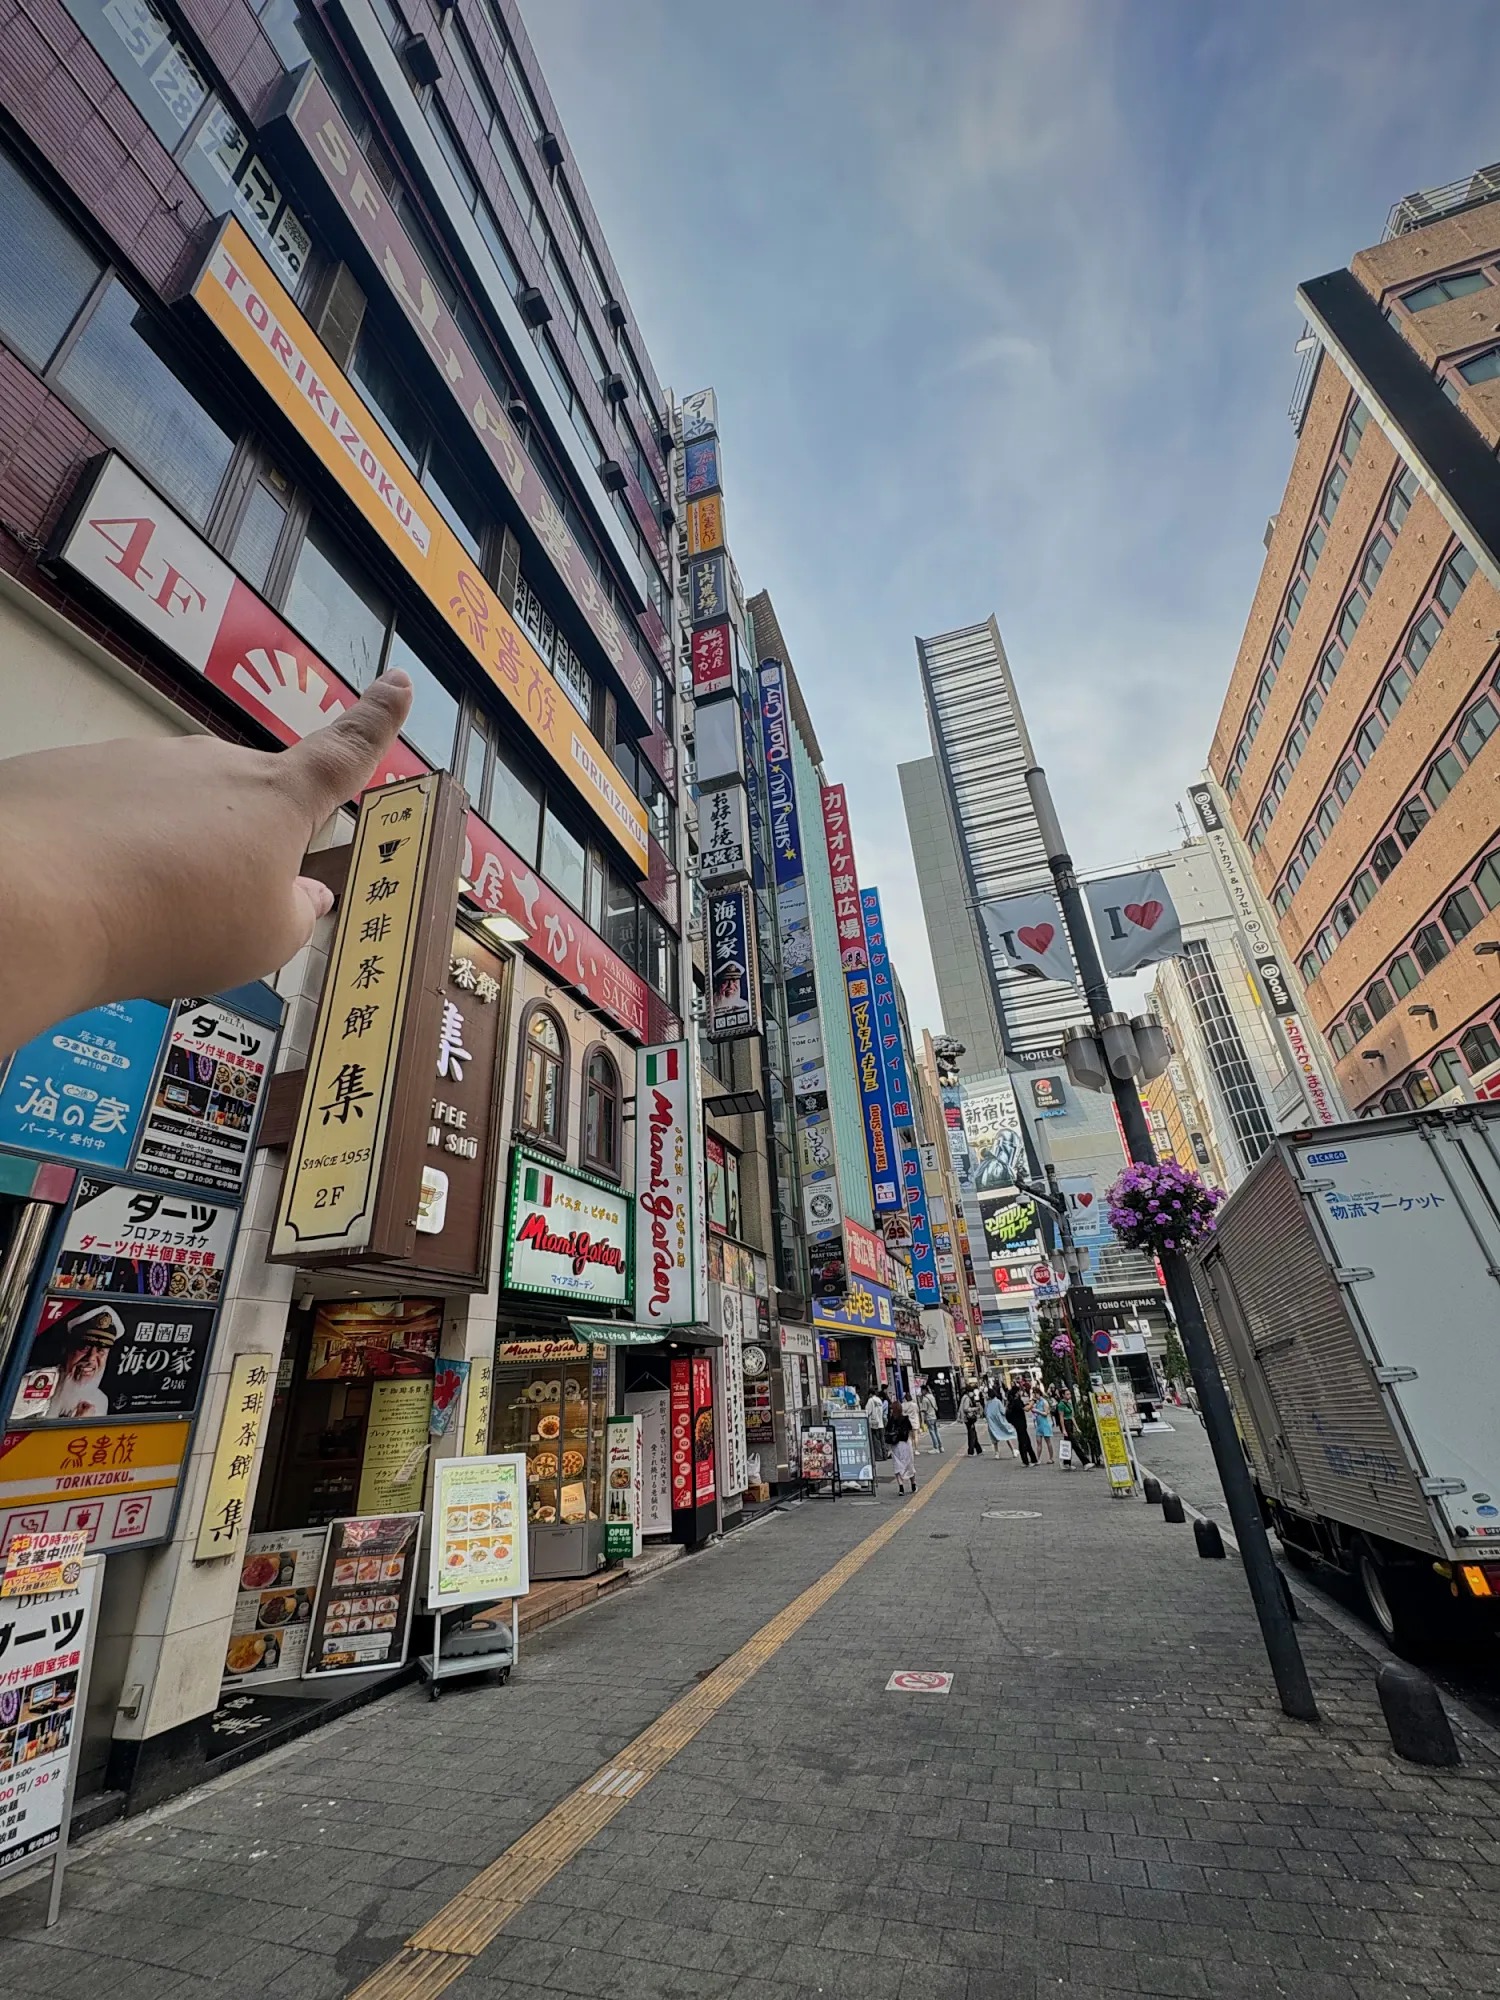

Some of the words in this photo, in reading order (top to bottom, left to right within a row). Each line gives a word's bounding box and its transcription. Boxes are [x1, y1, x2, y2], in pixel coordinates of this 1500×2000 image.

[222, 253, 413, 528] TORIKIZOKU
[316, 118, 380, 221] 5F
[384, 245, 624, 664] 山内農場
[88, 518, 207, 618] 4F
[698, 563, 718, 609] 山内農場
[449, 569, 556, 743] 鳥貴族
[704, 681, 722, 693] 4F
[571, 738, 644, 843] TORIKIZOKU
[381, 807, 413, 827] 70席
[710, 792, 734, 848] お好み焼
[773, 774, 790, 850] SHINJUKU
[1194, 792, 1218, 825] Booth
[703, 846, 742, 867] 大阪家
[823, 792, 861, 940] カラオケ歌広場
[713, 900, 738, 959] 海の家
[342, 875, 400, 1040] 珈琲茶館
[450, 955, 500, 1004] 茶館
[602, 953, 644, 1000] YAKINIKU
[1260, 963, 1288, 1006] Booth
[602, 977, 645, 1029] SAKAI
[77, 1029, 117, 1051] 居酒屋
[191, 1015, 261, 1056] ダーツ
[852, 1001, 879, 1092] マツモトキヨシ
[172, 1031, 265, 1075] ダーツ付半個室完備
[1020, 1051, 1052, 1061] HOTEL
[15, 1074, 130, 1134] 海の家
[318, 1063, 374, 1126] 集
[869, 1104, 882, 1130] Shop
[965, 1102, 1015, 1124] 新宿に
[968, 1117, 1018, 1136] 帰ってくる
[69, 1133, 106, 1150] 受付中
[649, 1088, 676, 1193] Miami
[873, 1131, 885, 1150] Free
[1318, 1151, 1346, 1162] CARGO
[301, 1155, 338, 1171] SINCE
[341, 1147, 371, 1166] 1953
[875, 1150, 888, 1172] Tax
[80, 1180, 99, 1197] 8F
[313, 1185, 345, 1209] 2F
[127, 1193, 218, 1234] ダーツ
[1330, 1192, 1445, 1221] 物流マーケット
[120, 1223, 210, 1249] フロアカラオケ
[516, 1212, 577, 1258] Miami
[903, 1161, 935, 1290] カラオケ館
[79, 1234, 217, 1268] ダーツ付半個室完備
[551, 1274, 596, 1290] マイアミガーデン
[47, 1301, 62, 1320] 7F
[1097, 1301, 1119, 1310] TOHO
[1121, 1298, 1157, 1309] CINEMAS
[136, 1323, 192, 1342] 居酒屋
[503, 1342, 542, 1356] Miami
[116, 1345, 196, 1376] 海の家
[160, 1376, 187, 1391] 2号店
[227, 1364, 268, 1480] 珈琲茶館
[3, 1435, 21, 1446] 6F
[59, 1433, 138, 1471] 鳥貴族
[55, 1470, 129, 1491] TORIKIZOKU
[209, 1498, 243, 1542] 集
[609, 1528, 630, 1536] OPEN
[33, 1533, 79, 1549] 10時から
